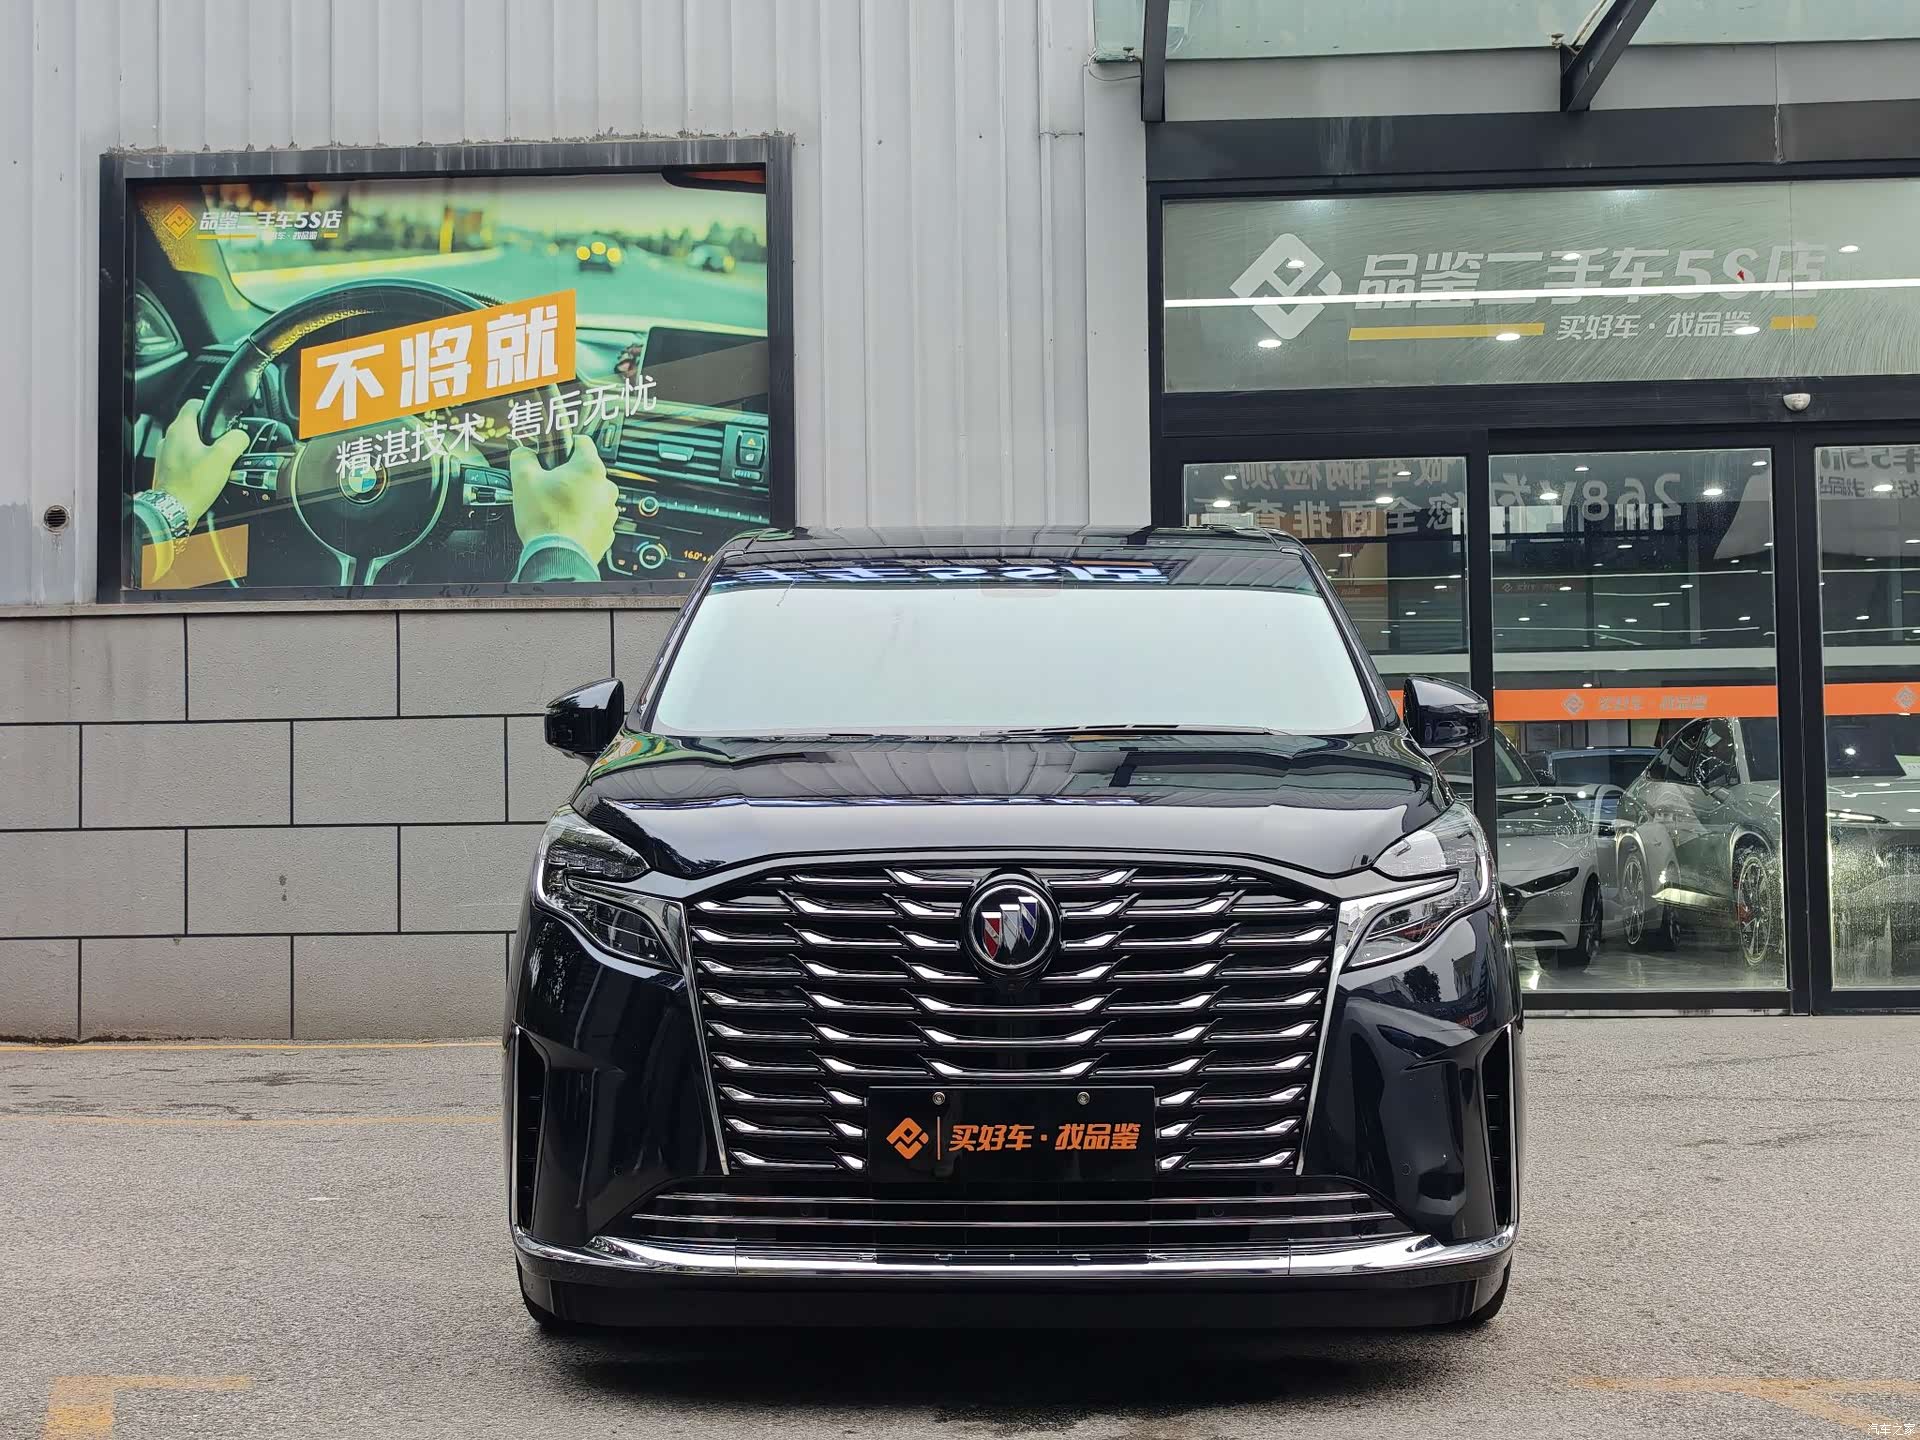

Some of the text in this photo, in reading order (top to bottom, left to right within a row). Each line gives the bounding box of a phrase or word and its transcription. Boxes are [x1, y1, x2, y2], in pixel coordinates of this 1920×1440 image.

[199, 209, 343, 230] 品鉴二手车5S店
[1355, 243, 1827, 309] 品鉴二手车5S店
[315, 304, 558, 421] 不将就
[336, 374, 657, 478] 精湛技术 售后无忧
[949, 1123, 1141, 1151] 买好车·找品鉴
